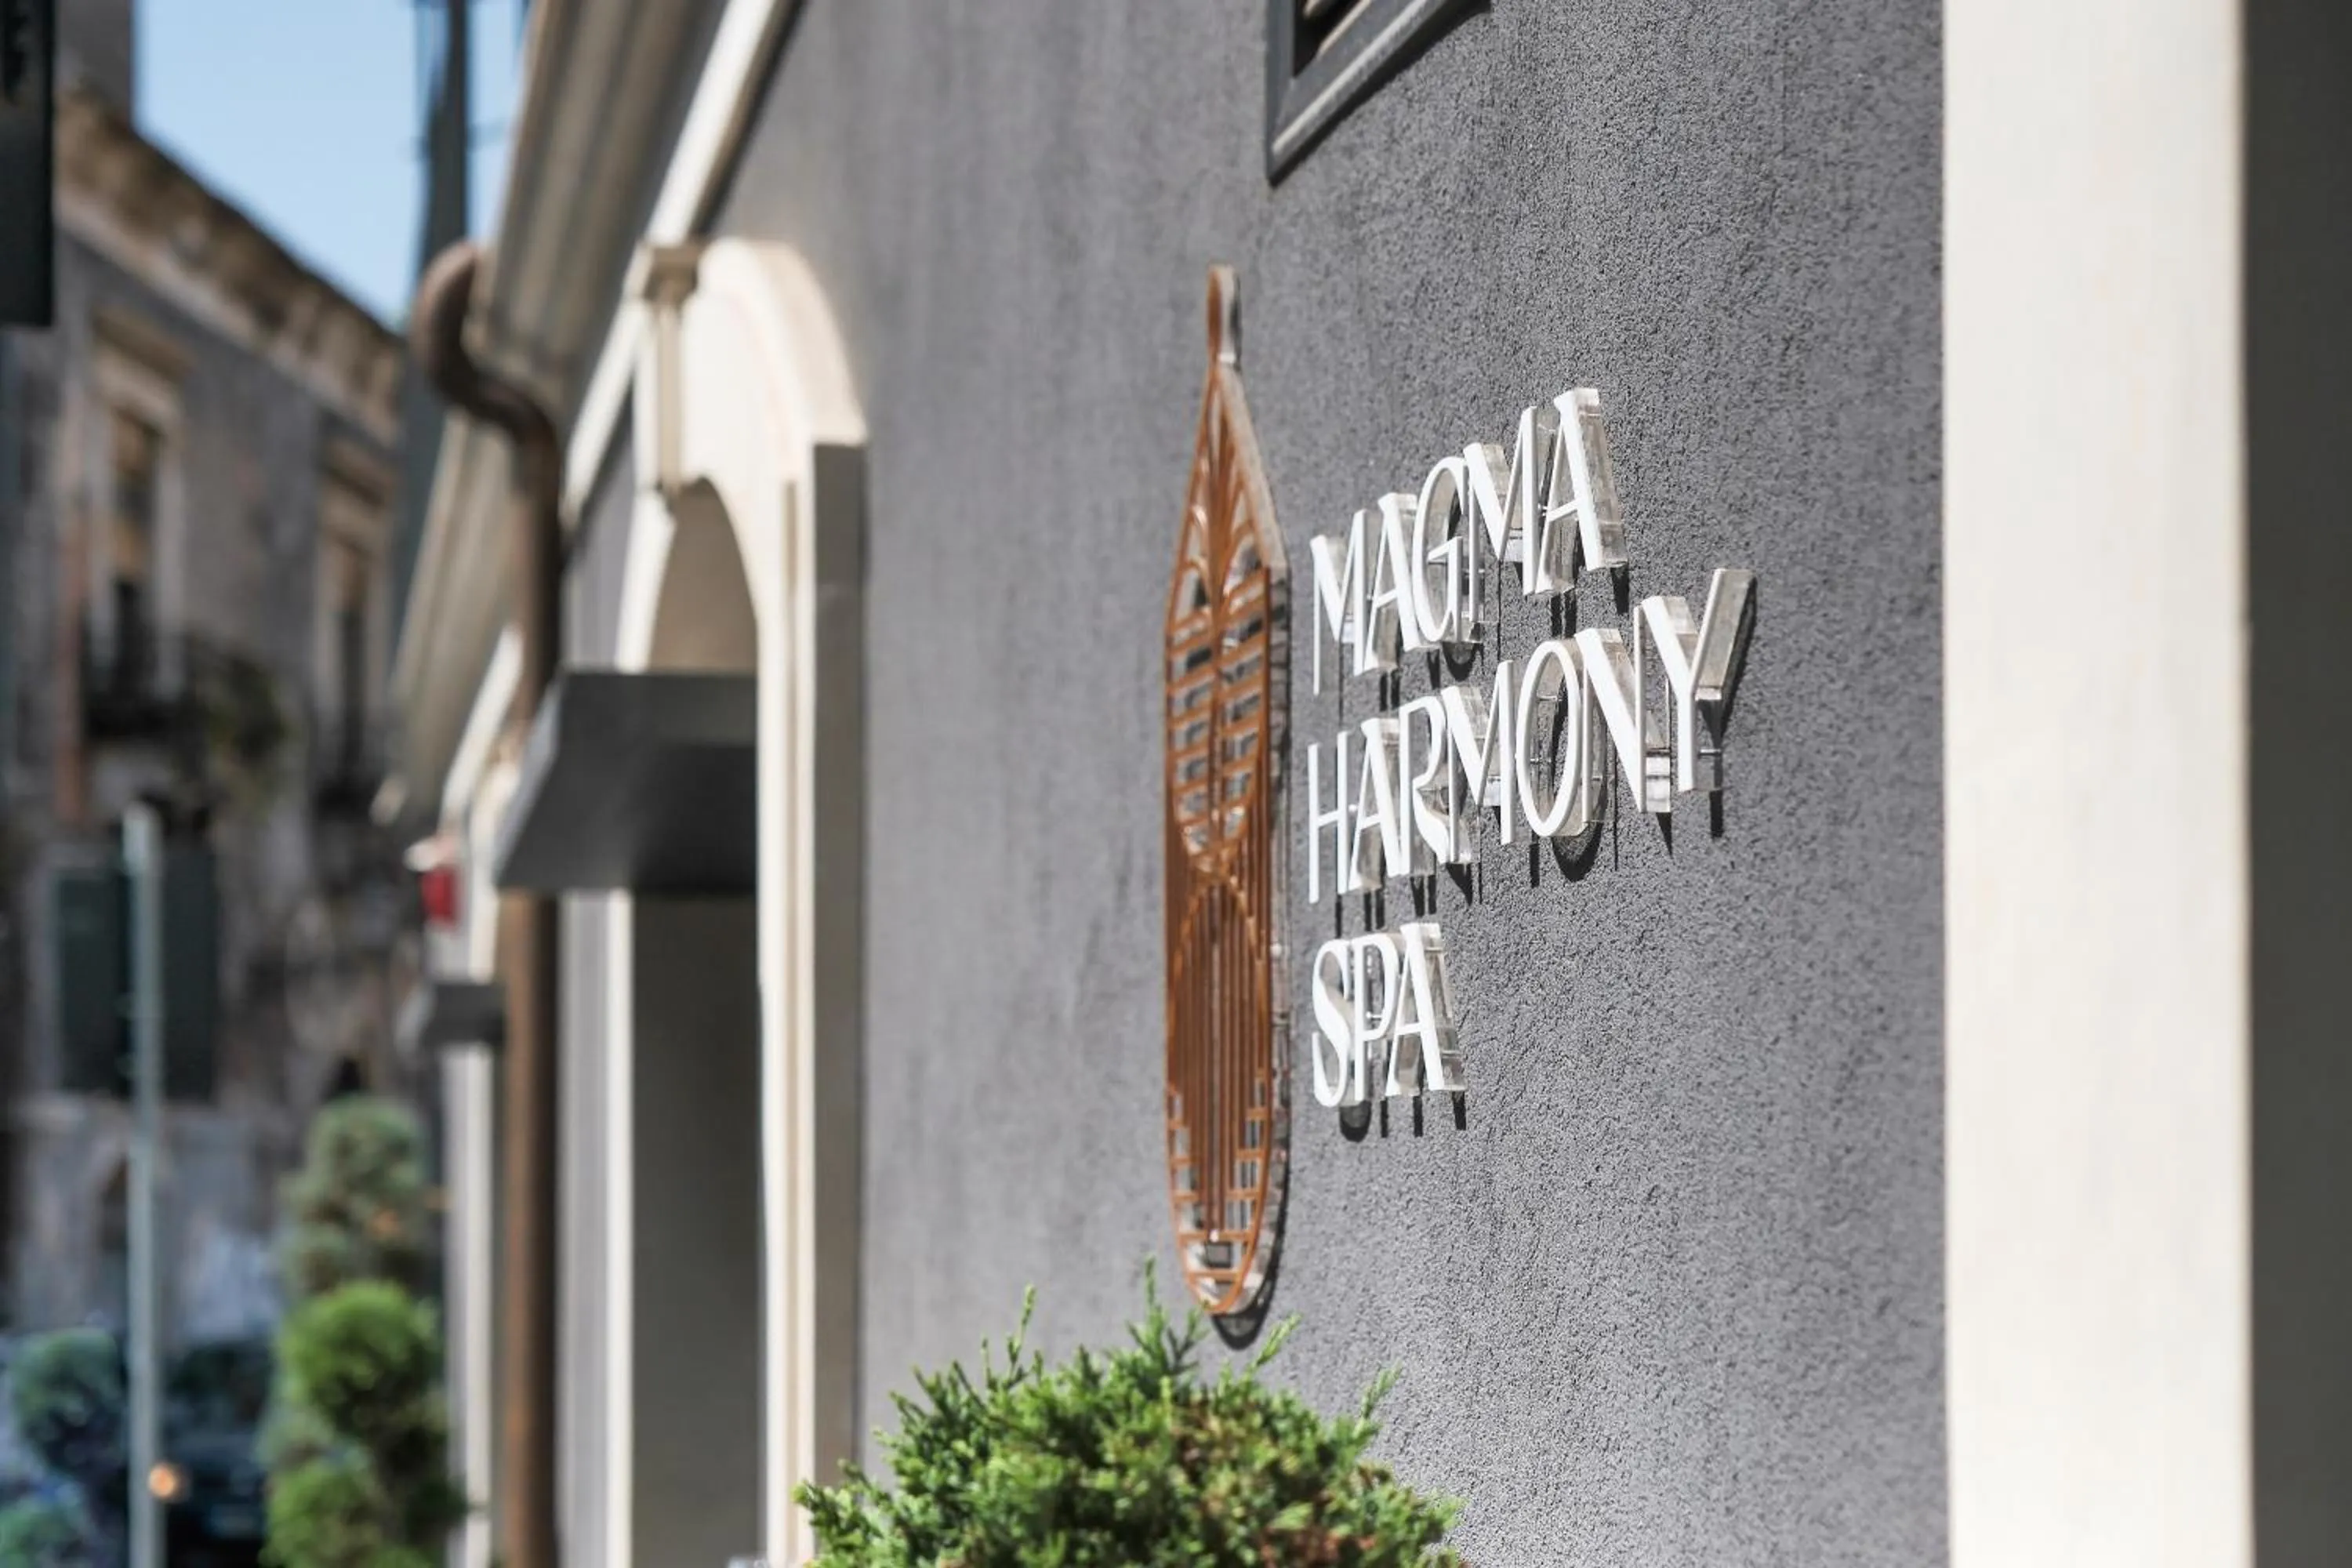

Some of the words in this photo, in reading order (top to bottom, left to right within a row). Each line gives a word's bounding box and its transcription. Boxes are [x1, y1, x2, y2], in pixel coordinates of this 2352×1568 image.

[1310, 387, 1624, 697] MAGMA
[1308, 568, 1755, 904] HARMONY
[1312, 923, 1465, 1107] SPA
